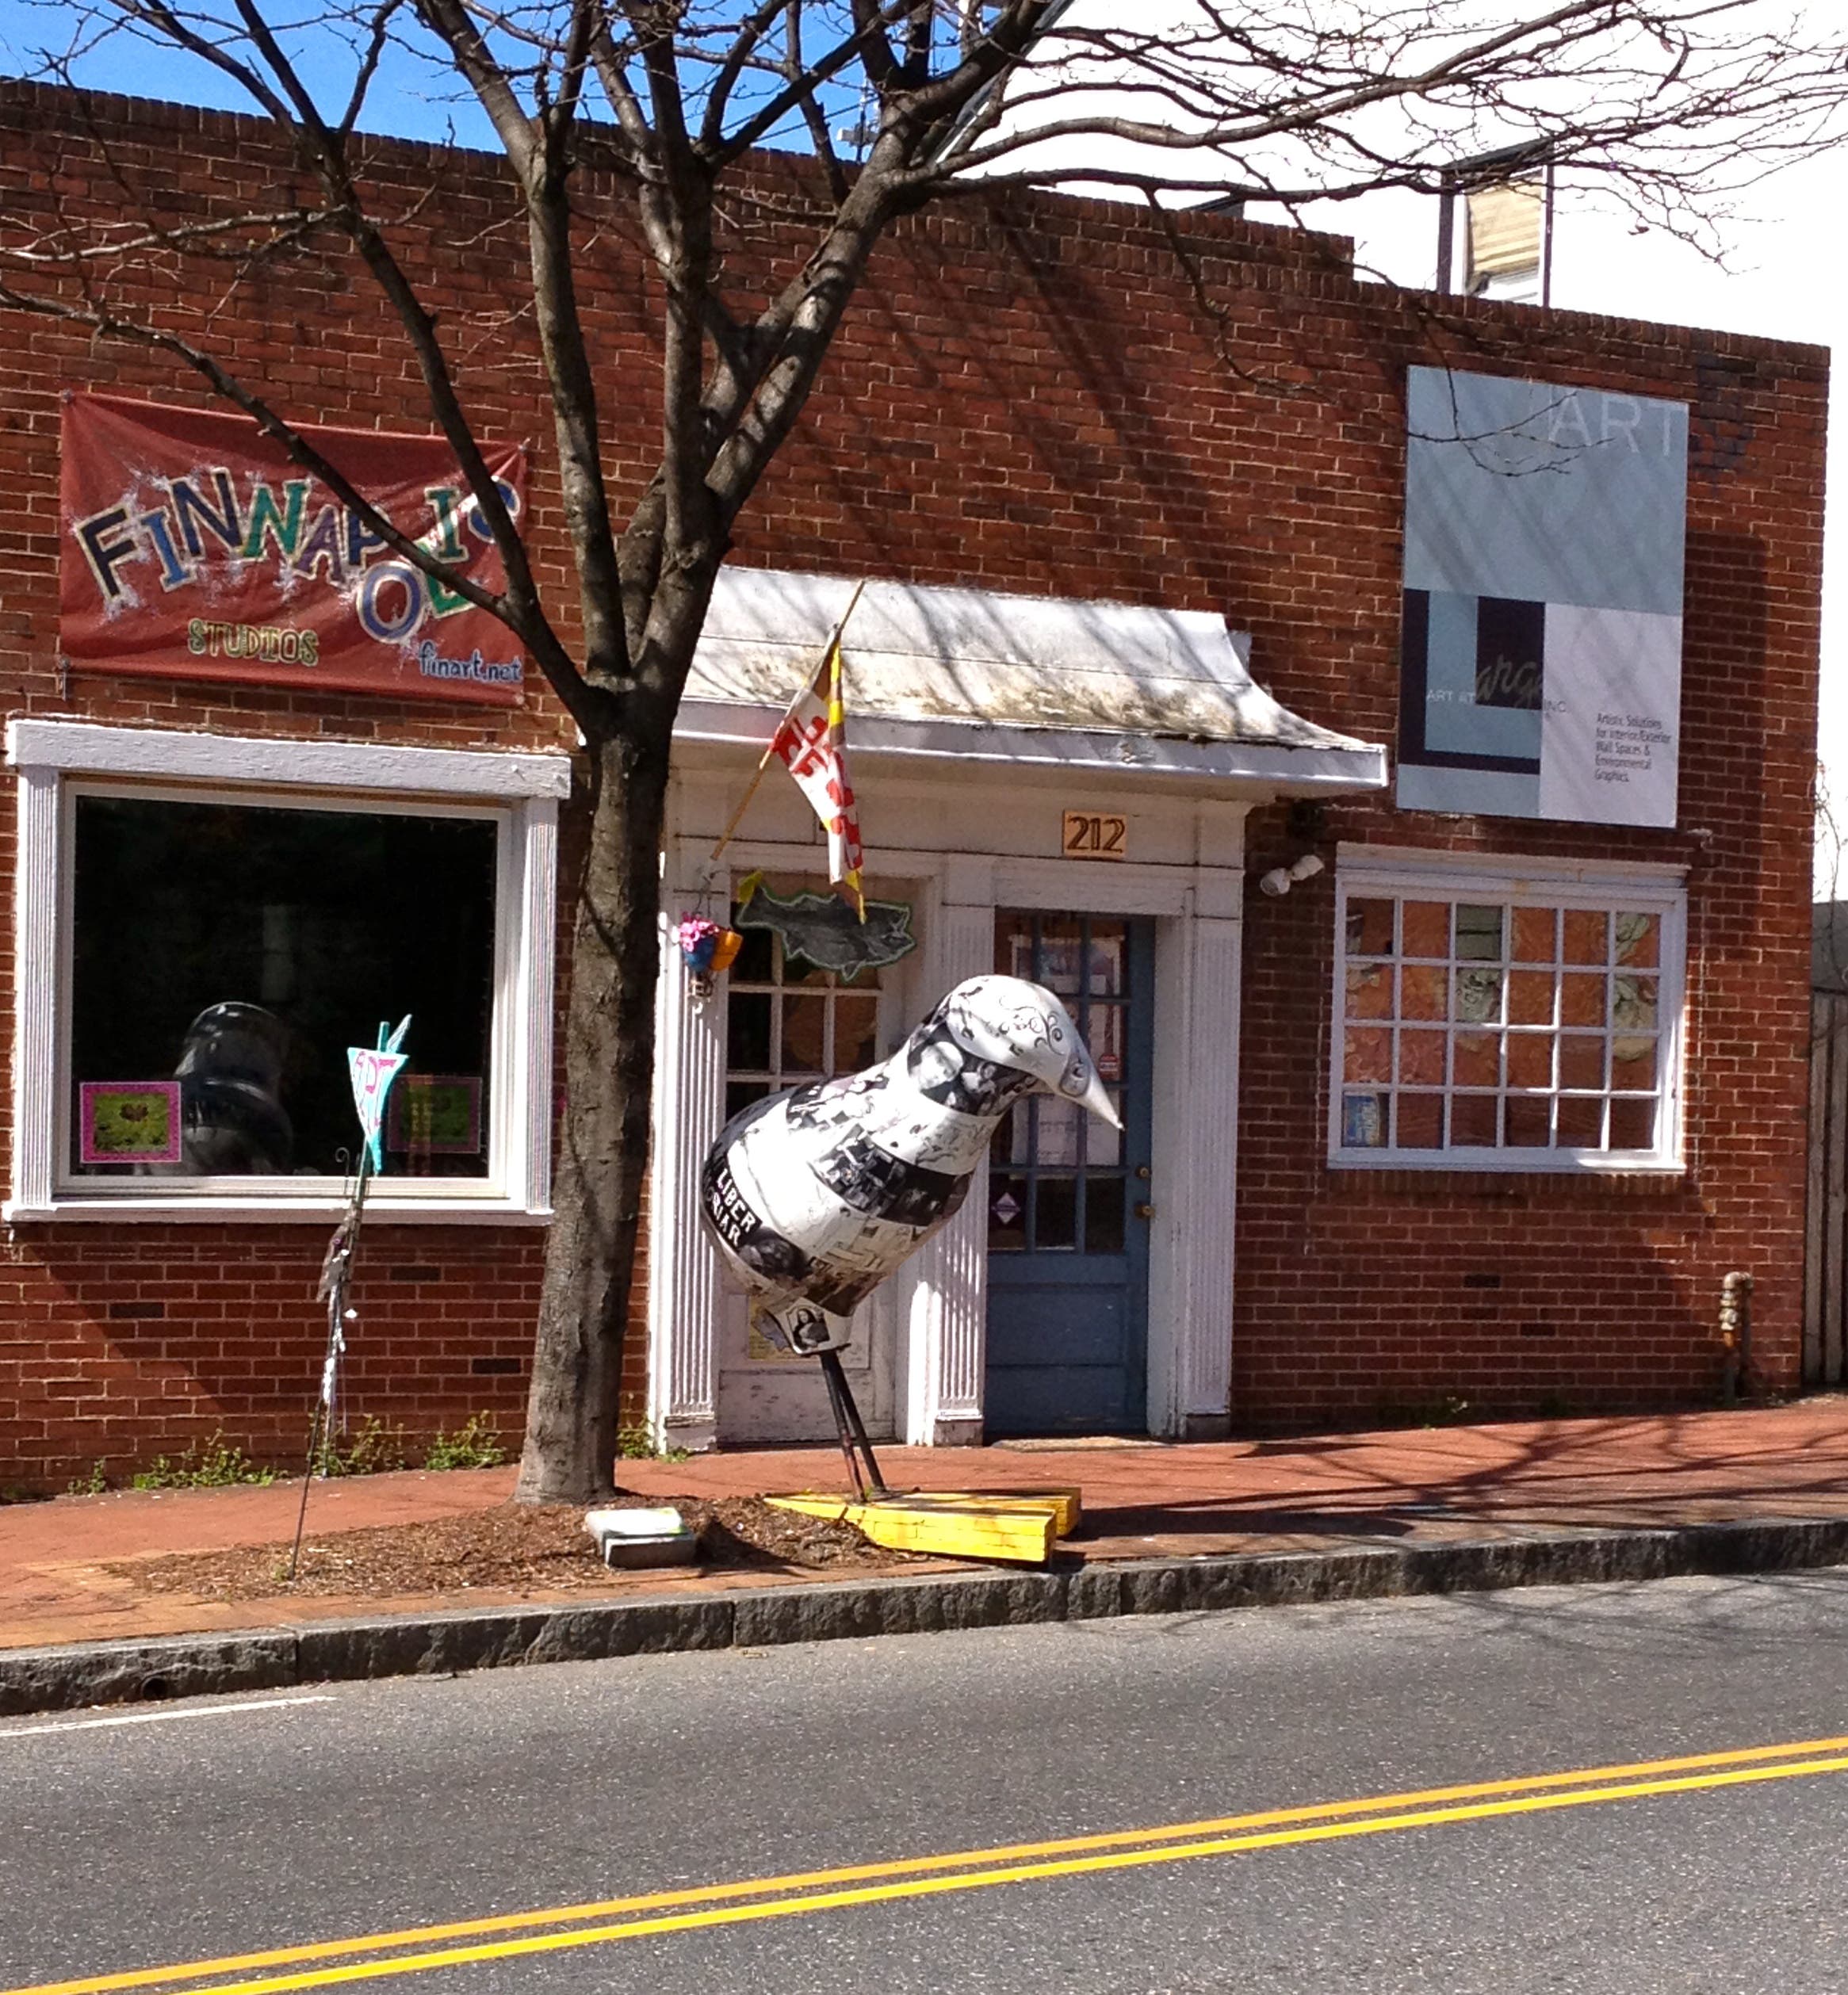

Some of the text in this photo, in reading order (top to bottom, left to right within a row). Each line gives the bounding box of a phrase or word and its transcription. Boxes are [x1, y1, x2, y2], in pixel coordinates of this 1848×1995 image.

[1548, 388, 1688, 456] ART
[188, 617, 319, 667] STUDIOS
[1427, 689, 1453, 702] ART
[1067, 816, 1126, 853] 212
[716, 1167, 756, 1233] LIBER
